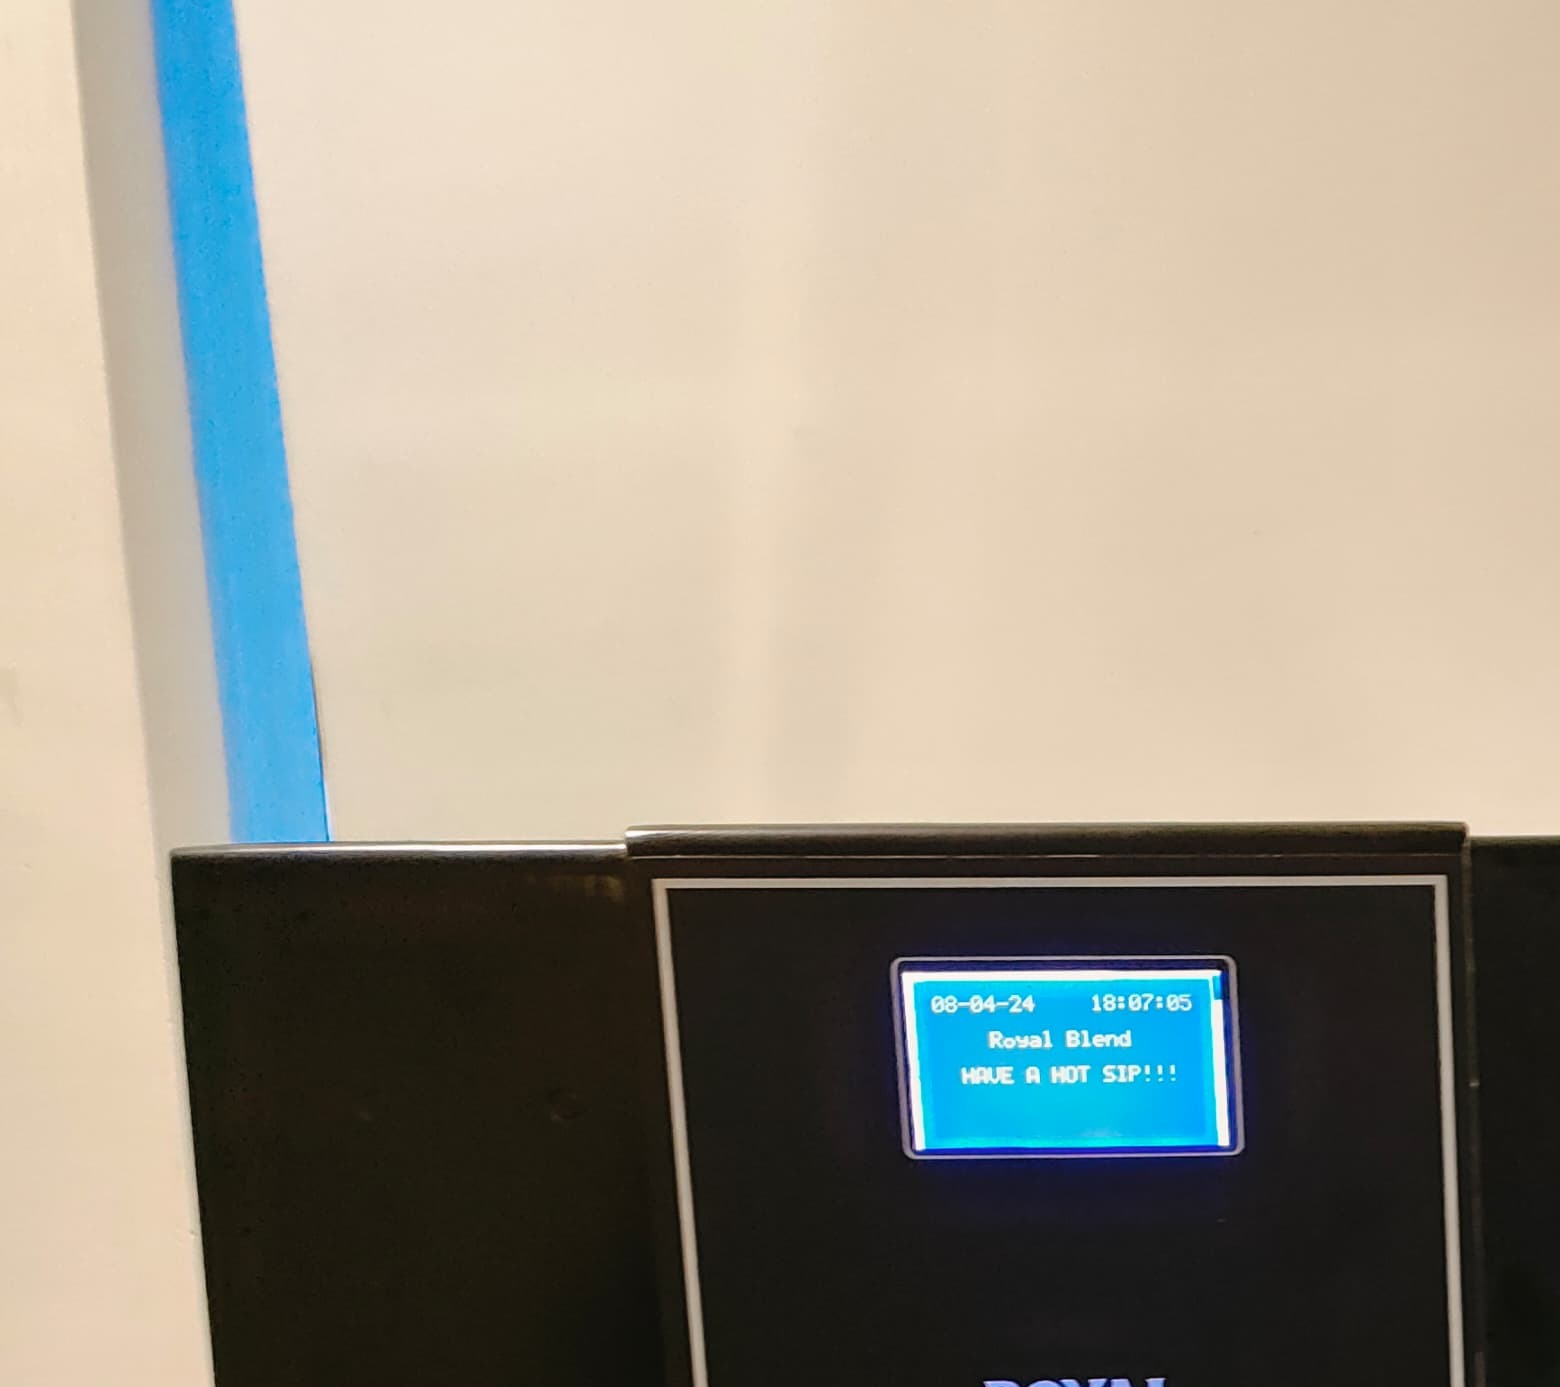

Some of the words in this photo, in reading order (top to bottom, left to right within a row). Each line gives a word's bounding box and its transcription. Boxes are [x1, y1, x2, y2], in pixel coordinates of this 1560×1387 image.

[931, 994, 1036, 1014] 08-04-24
[1091, 992, 1192, 1012] 18:07:05
[988, 1030, 1053, 1049] Royal
[1065, 1029, 1132, 1048] Blend
[960, 1066, 1015, 1085] HAVE
[1025, 1066, 1041, 1084] A
[1050, 1065, 1092, 1084] HOT
[1102, 1064, 1177, 1083] SIP!!!
